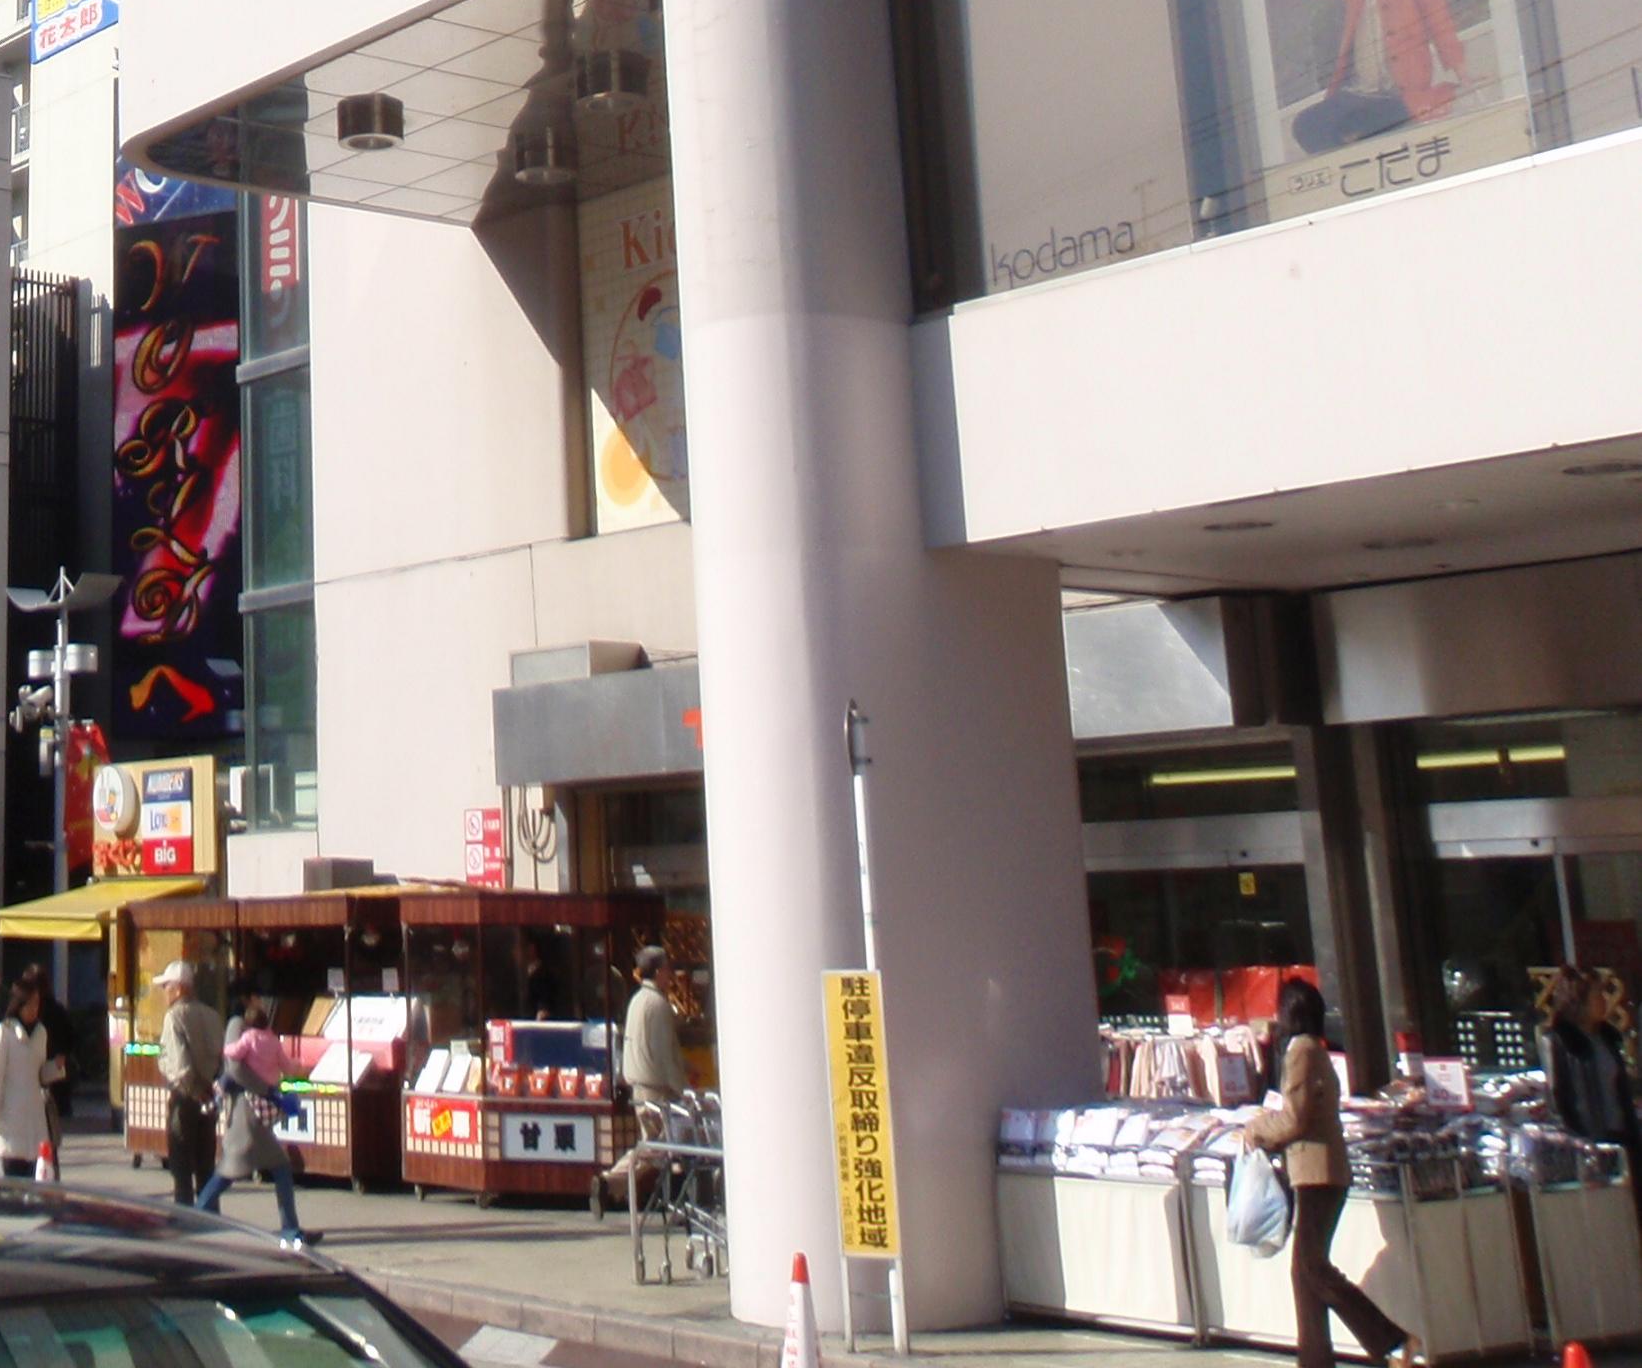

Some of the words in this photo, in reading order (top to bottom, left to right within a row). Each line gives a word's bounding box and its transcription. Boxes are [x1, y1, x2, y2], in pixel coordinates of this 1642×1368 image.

[1339, 136, 1450, 197] こだま
[991, 221, 1136, 289] kodama
[153, 846, 177, 865] BIG
[840, 976, 889, 1248] 駐停車違反取締り強化地域
